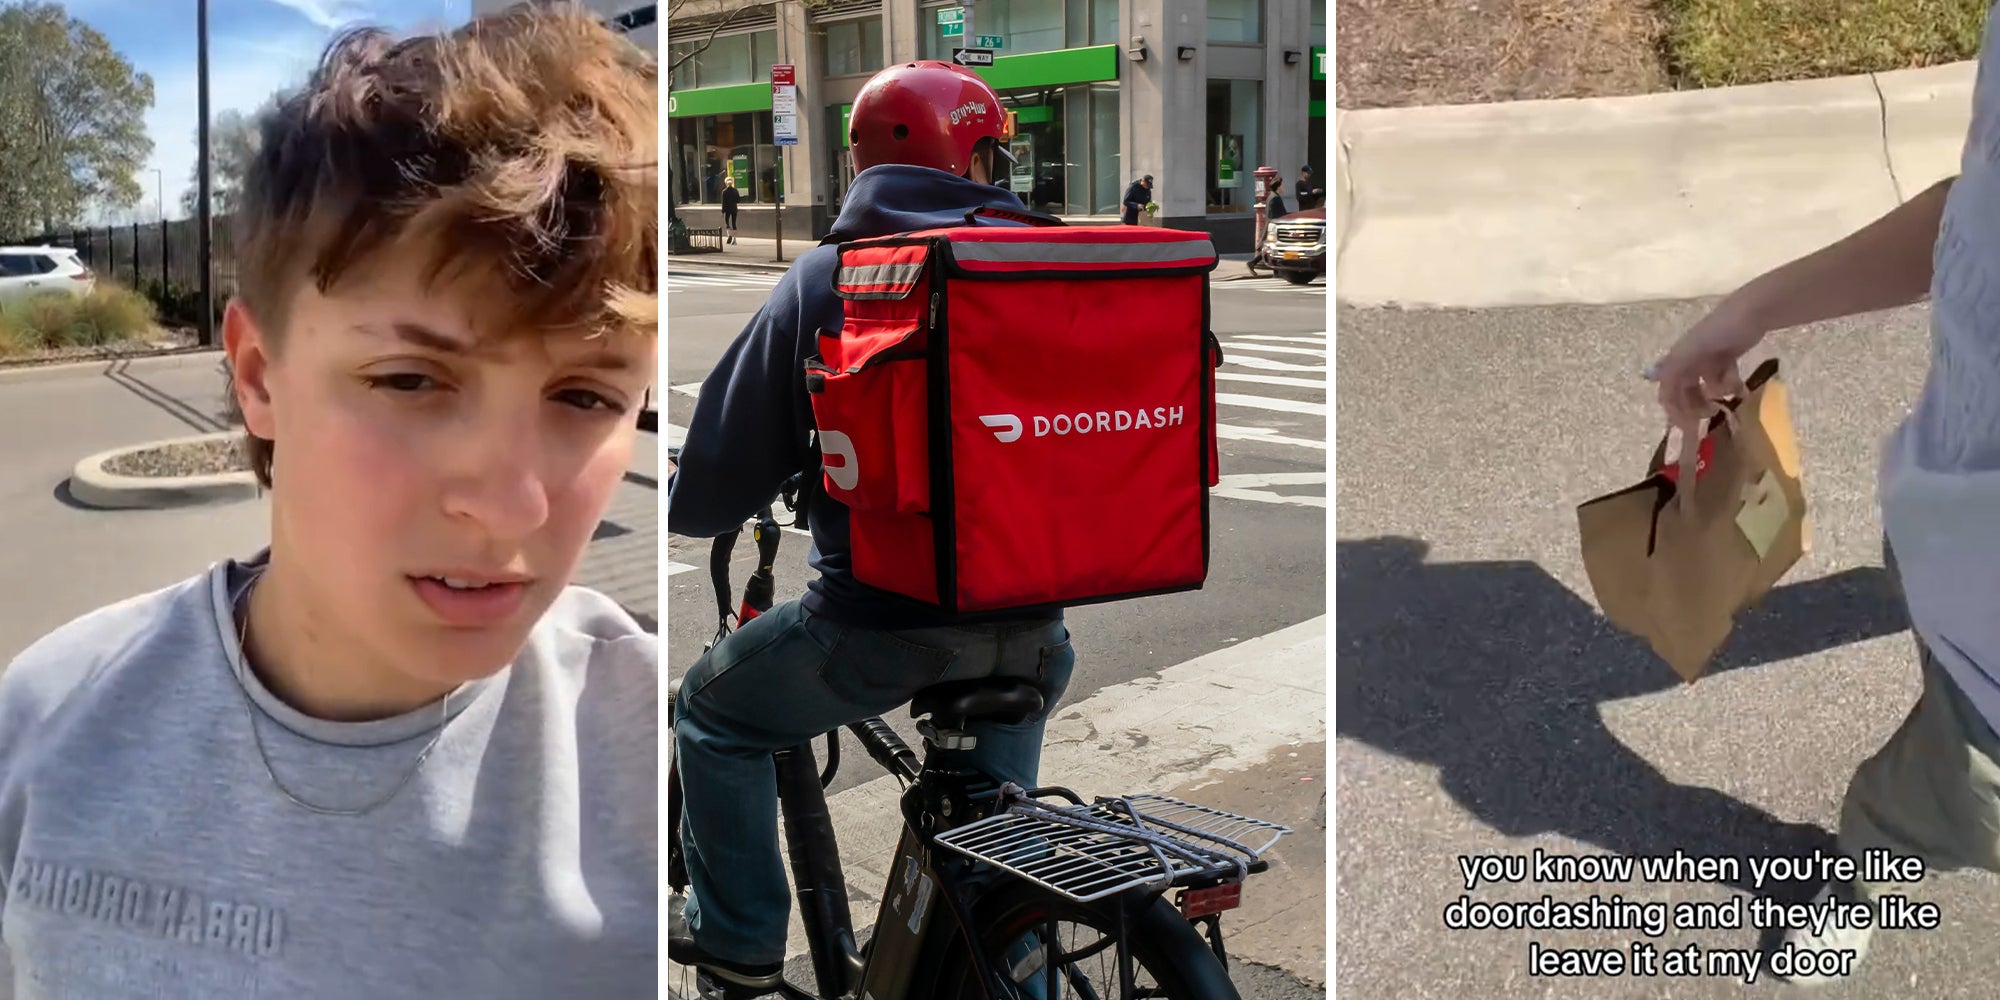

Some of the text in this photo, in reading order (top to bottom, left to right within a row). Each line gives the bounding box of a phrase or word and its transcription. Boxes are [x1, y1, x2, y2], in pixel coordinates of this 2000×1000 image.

[976, 37, 982, 47] W
[984, 37, 994, 47] 26
[1033, 405, 1184, 437] DOORDASH
